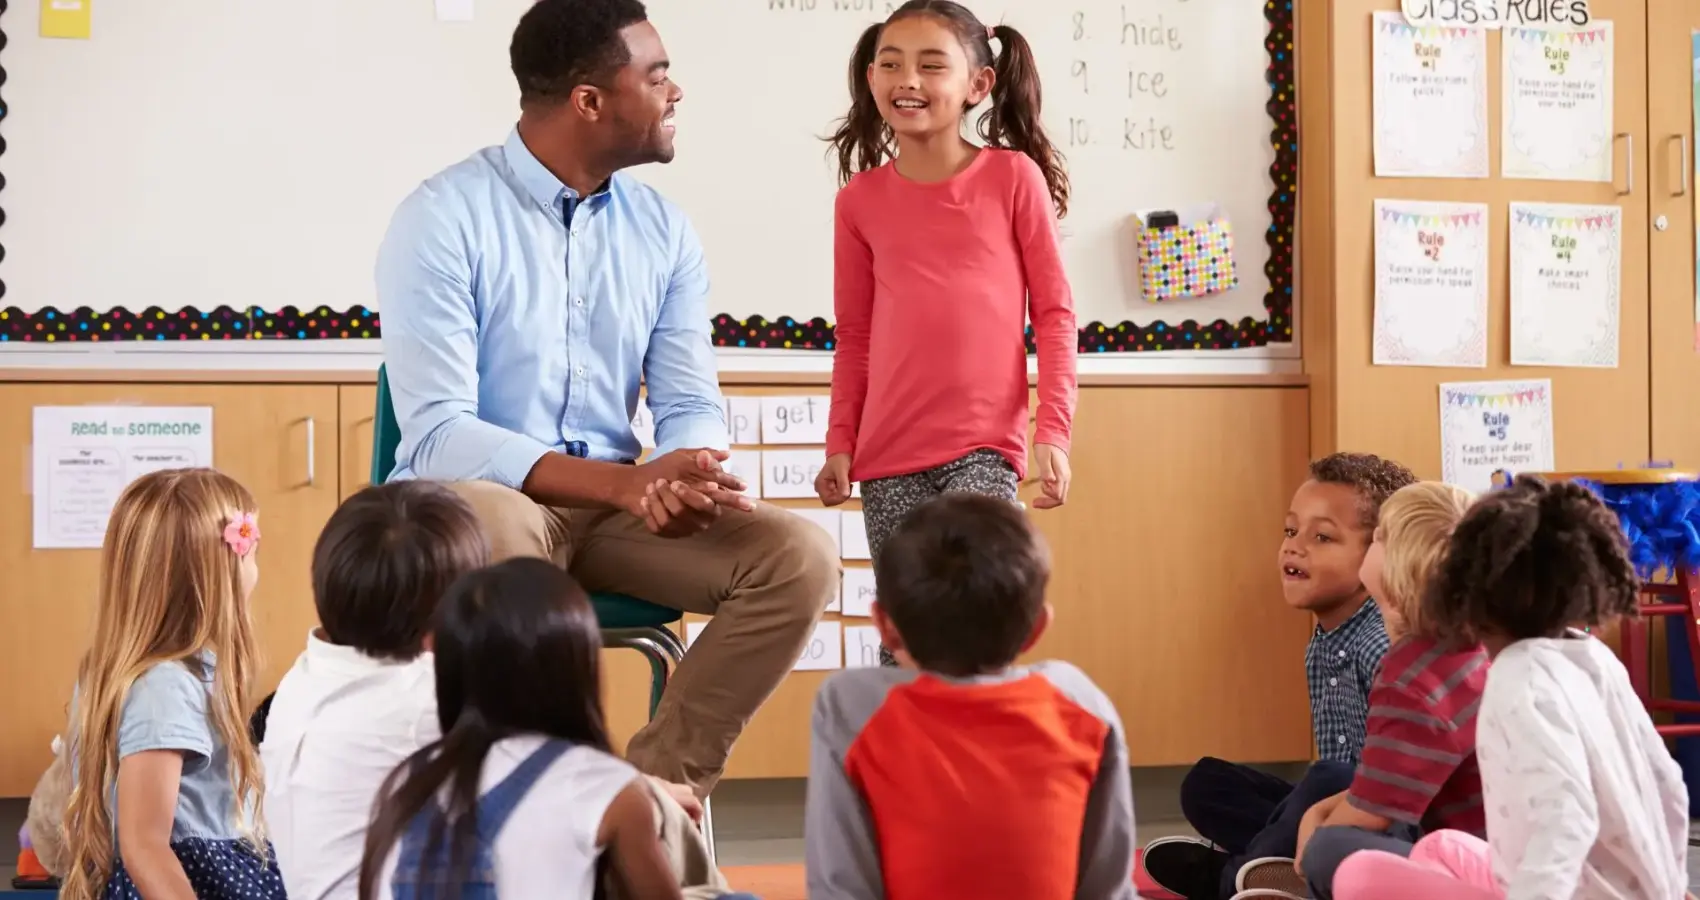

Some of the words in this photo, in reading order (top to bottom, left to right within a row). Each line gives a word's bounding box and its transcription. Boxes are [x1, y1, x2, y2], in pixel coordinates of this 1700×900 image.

[1408, 0, 1498, 24] Class
[1505, 0, 1588, 26] Rules
[1120, 4, 1183, 51] hide
[1414, 42, 1441, 57] Rule
[1544, 45, 1570, 60] Rule
[1127, 61, 1168, 98] ice
[1122, 116, 1175, 151] kite
[1417, 230, 1445, 246] Rule
[1551, 234, 1577, 249] Rule
[774, 397, 817, 434] get
[1482, 411, 1510, 426] Rule
[71, 419, 107, 435] Read
[128, 421, 201, 436] someone
